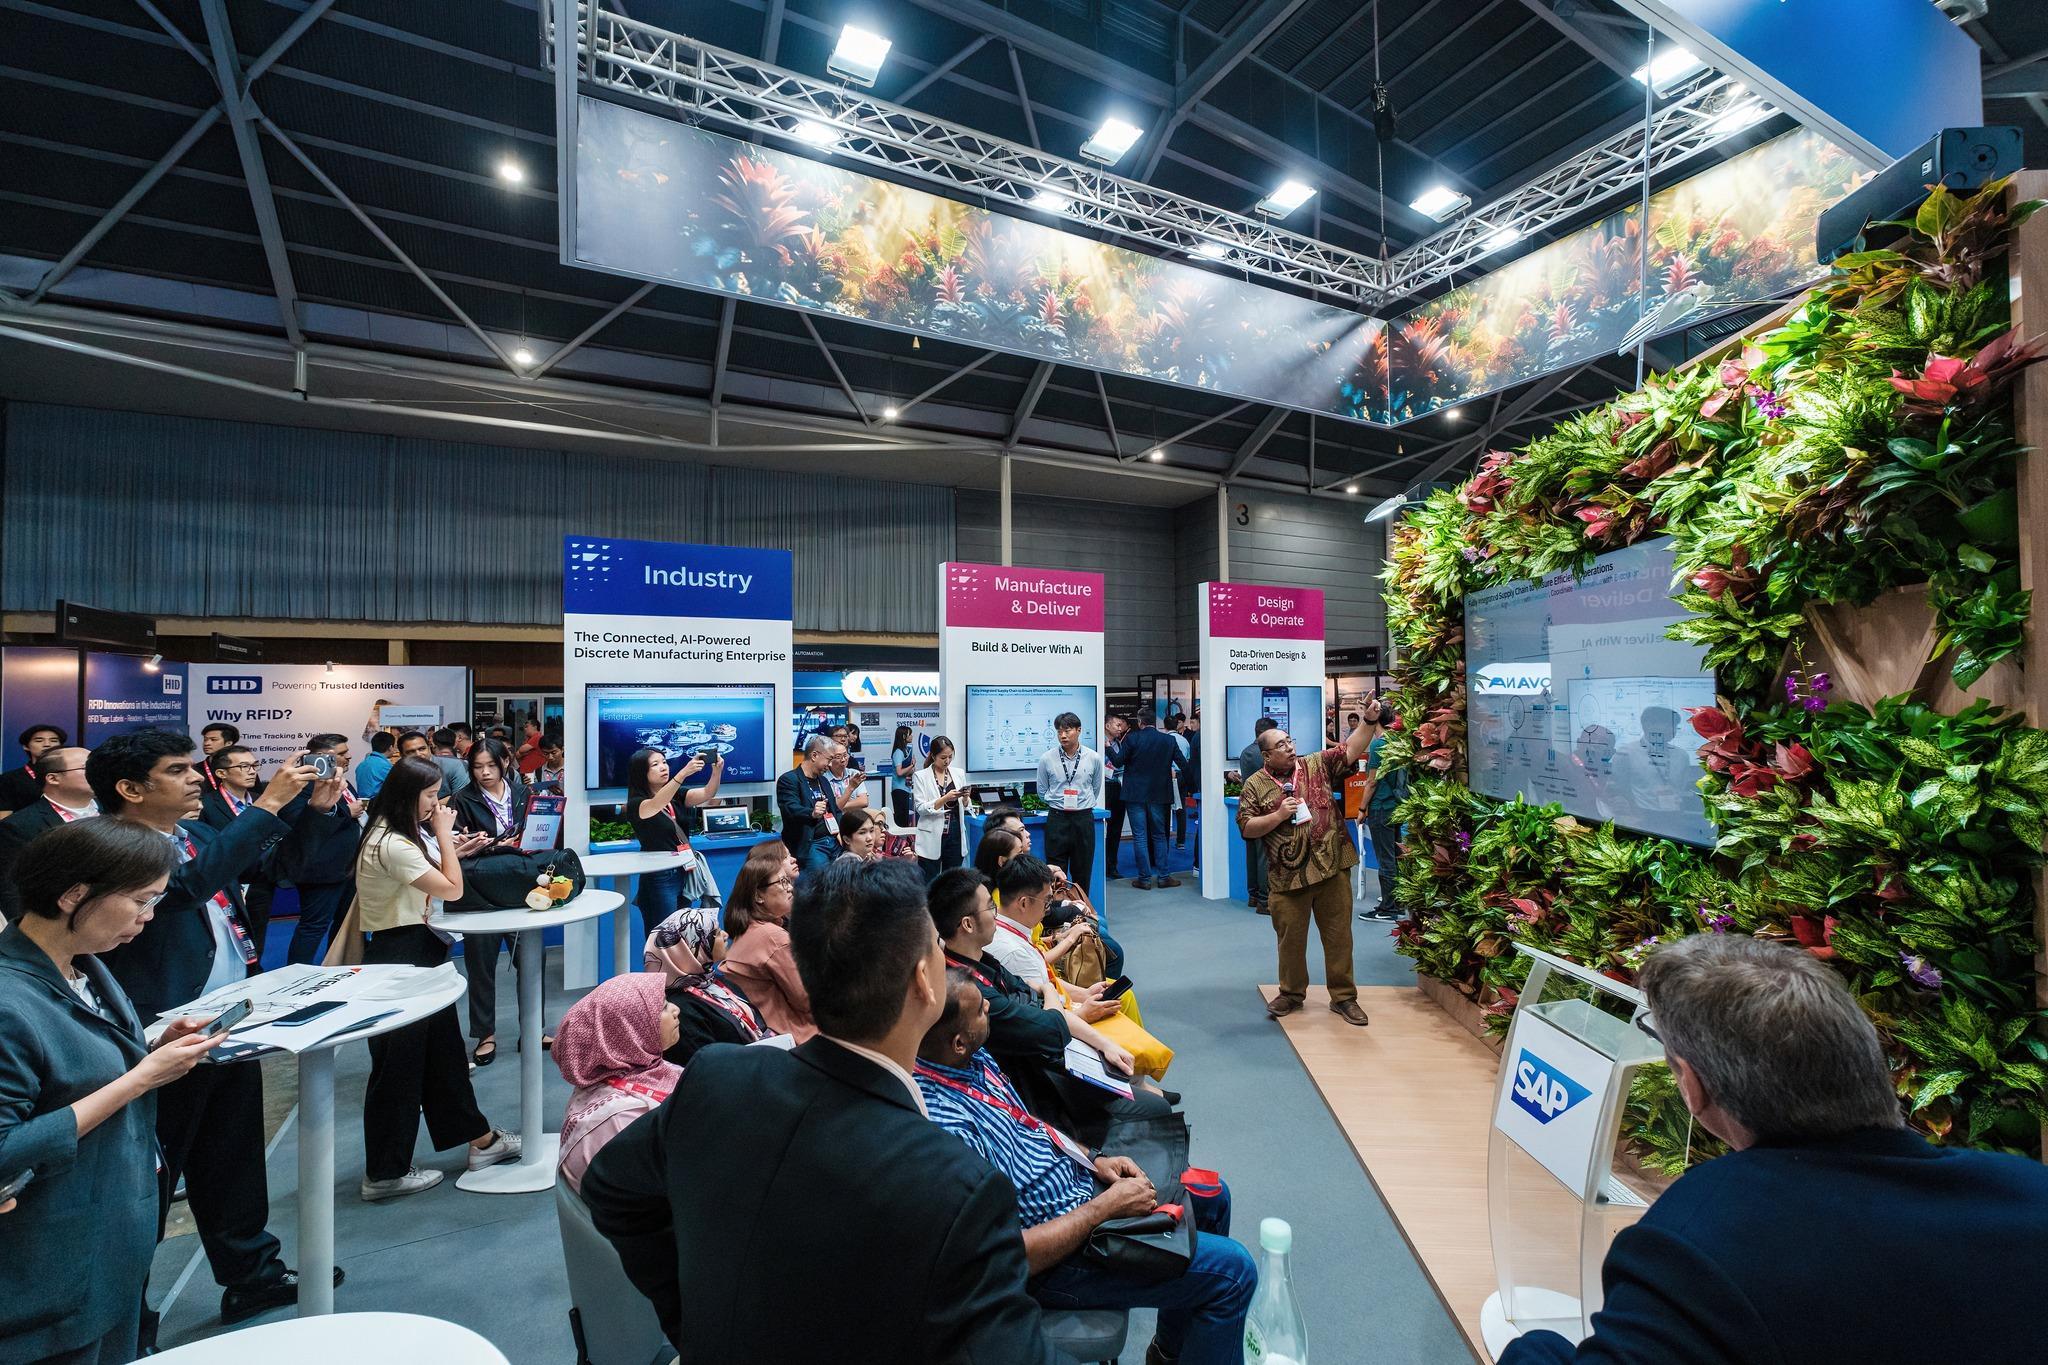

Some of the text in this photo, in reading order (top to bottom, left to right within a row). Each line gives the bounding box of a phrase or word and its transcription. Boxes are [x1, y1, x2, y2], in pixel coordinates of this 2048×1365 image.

[1236, 503, 1249, 526] 3
[644, 565, 753, 594] Industry
[995, 576, 1092, 597] Manufacture
[1498, 590, 1515, 602] Supply
[1515, 586, 1529, 597] Chain
[1553, 572, 1575, 585] Efficien
[1582, 562, 1614, 580] perations
[1011, 600, 1081, 616] & Deliver
[1257, 596, 1294, 611] Design
[1250, 613, 1304, 627] & Operate
[574, 631, 751, 646] The Connected, AI-Powered
[971, 641, 1083, 655] Build & Deliver With AI
[574, 647, 786, 664] Discrete Manufacturing Enterprise
[1229, 649, 1306, 662] Data-Driven Design &
[1229, 661, 1268, 673] Operation
[164, 678, 181, 690] HID
[211, 679, 257, 691] HID
[271, 681, 405, 692] Powering Trusted Identities
[890, 685, 939, 697] MOVAN
[88, 699, 103, 710] RFID
[104, 700, 135, 710] Innovations
[149, 701, 171, 710] Industrial
[171, 701, 182, 710] Field
[206, 709, 293, 723] Why RFID?
[603, 712, 643, 721] Enterprise
[896, 720, 918, 728] SYSTEM
[263, 732, 296, 741] Tracking
[259, 745, 297, 753] Efficiency
[1514, 1060, 1569, 1118] SAP
